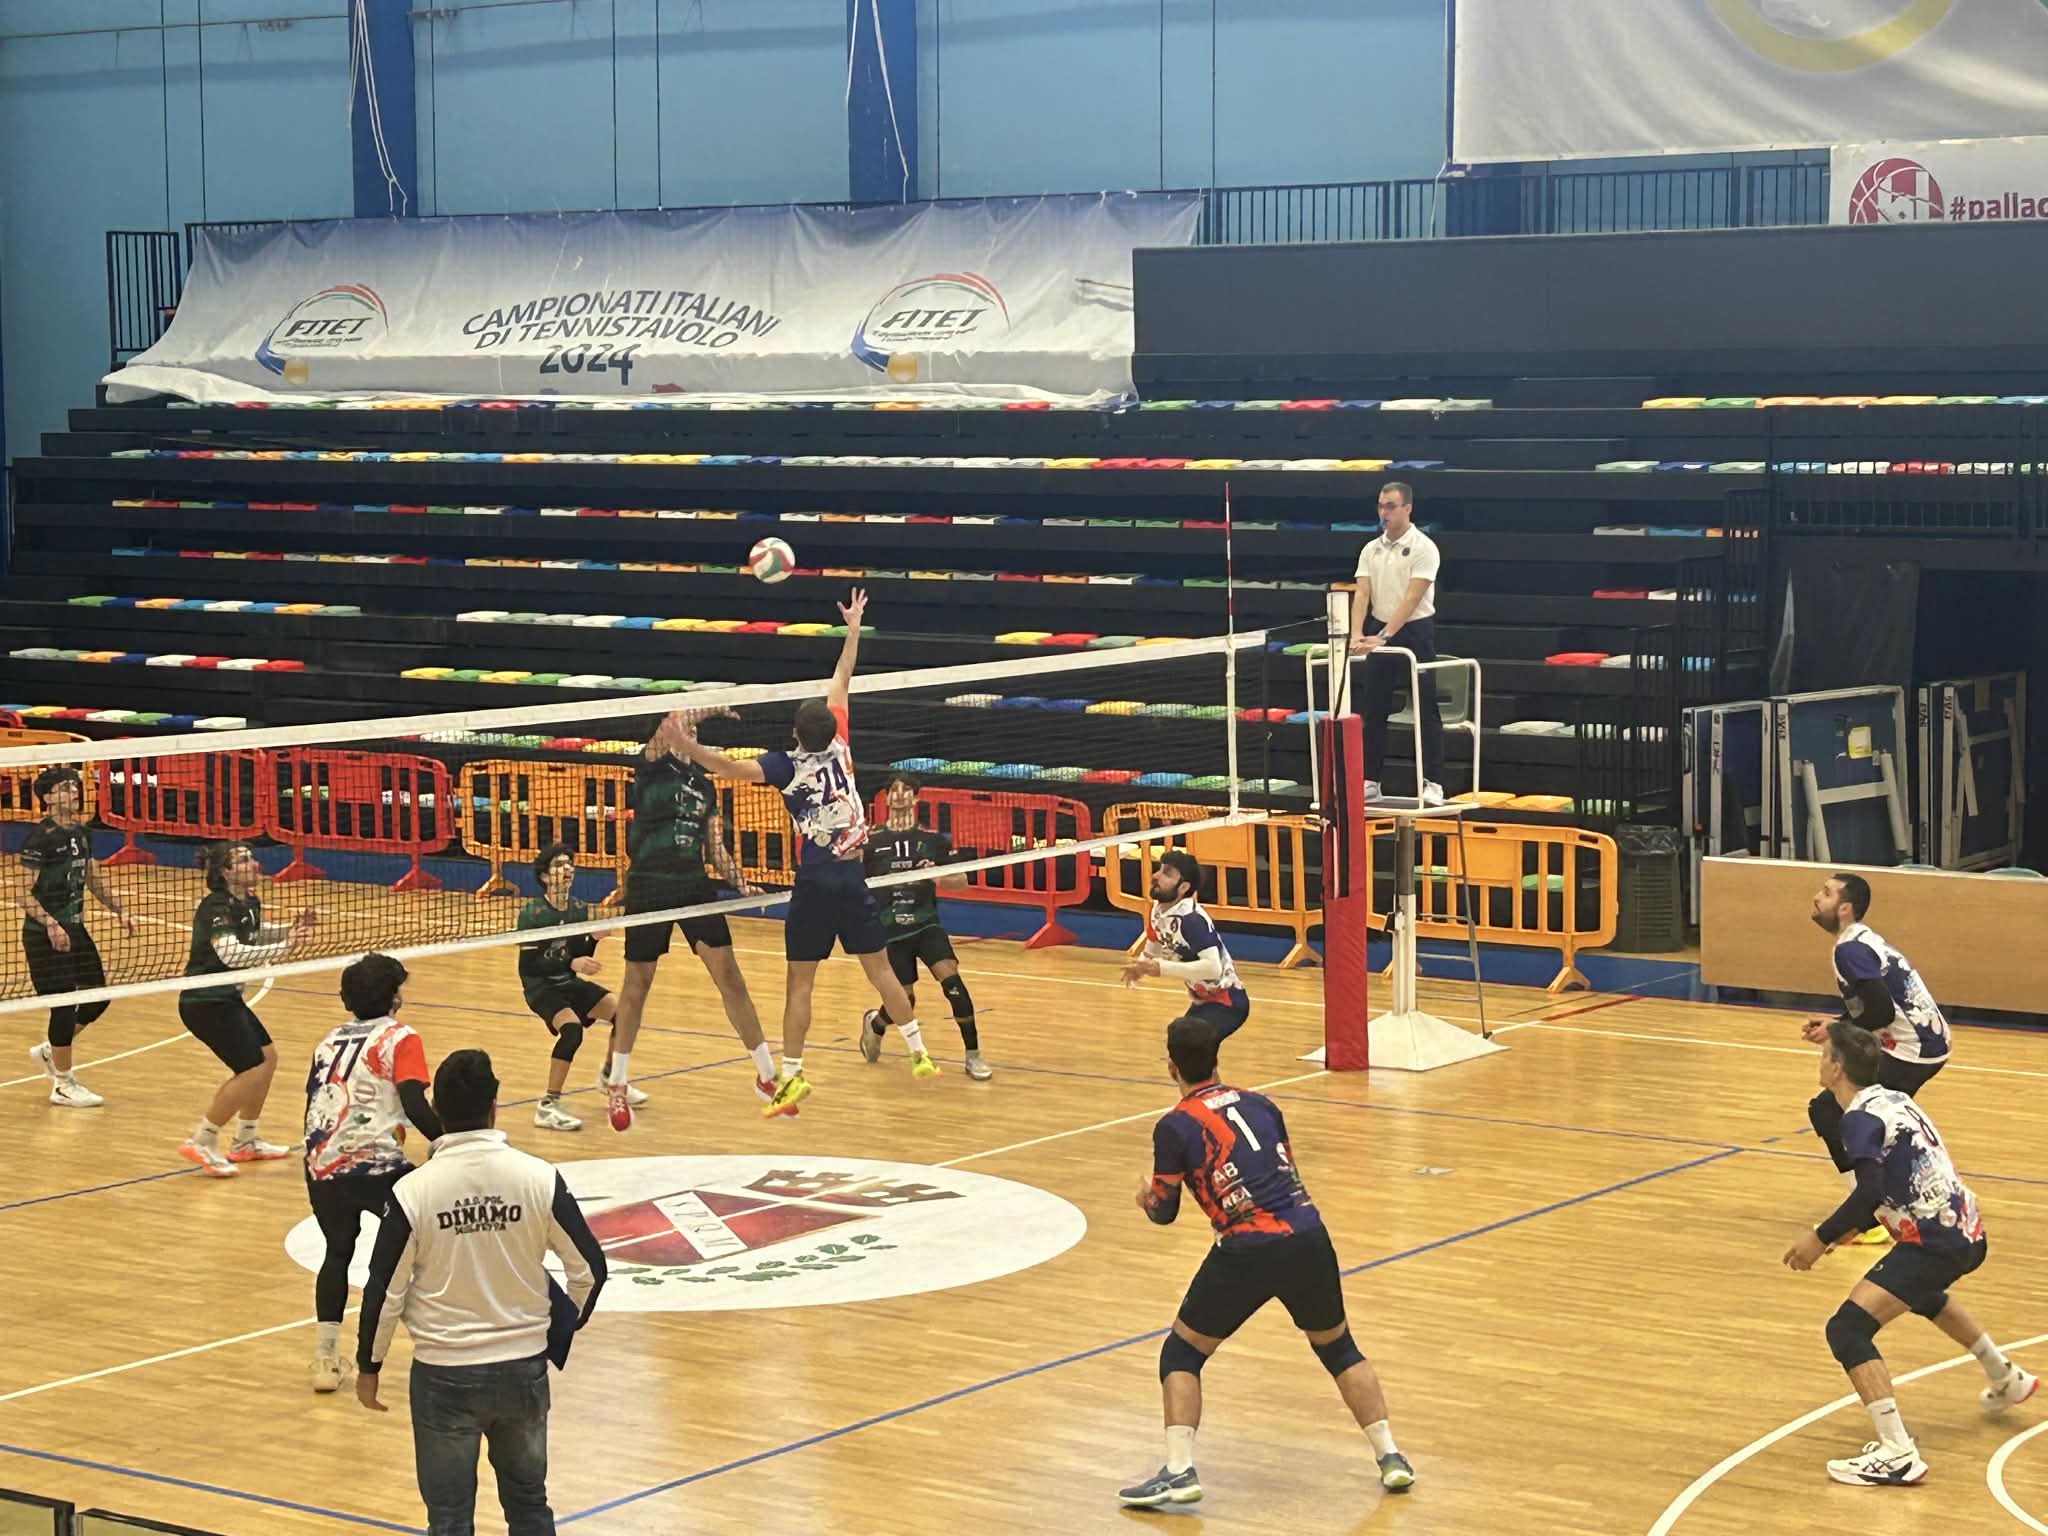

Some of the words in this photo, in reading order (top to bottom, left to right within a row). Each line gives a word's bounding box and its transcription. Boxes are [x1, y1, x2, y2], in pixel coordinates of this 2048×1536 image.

[285, 317, 373, 337] FITET
[463, 290, 662, 335] CAMPIONATI
[668, 290, 783, 338] ITALIANI
[474, 328, 512, 350] DI
[515, 315, 740, 349] TENNISTAVOLO
[881, 308, 988, 329] FITET
[540, 343, 642, 386] 2024
[815, 758, 850, 806] 24
[70, 837, 80, 856] 5
[895, 840, 910, 857] 11
[325, 1036, 369, 1085] 77
[1226, 1106, 1262, 1152] 1
[1903, 1105, 1939, 1147] 8
[436, 1204, 522, 1230] DINAMO
